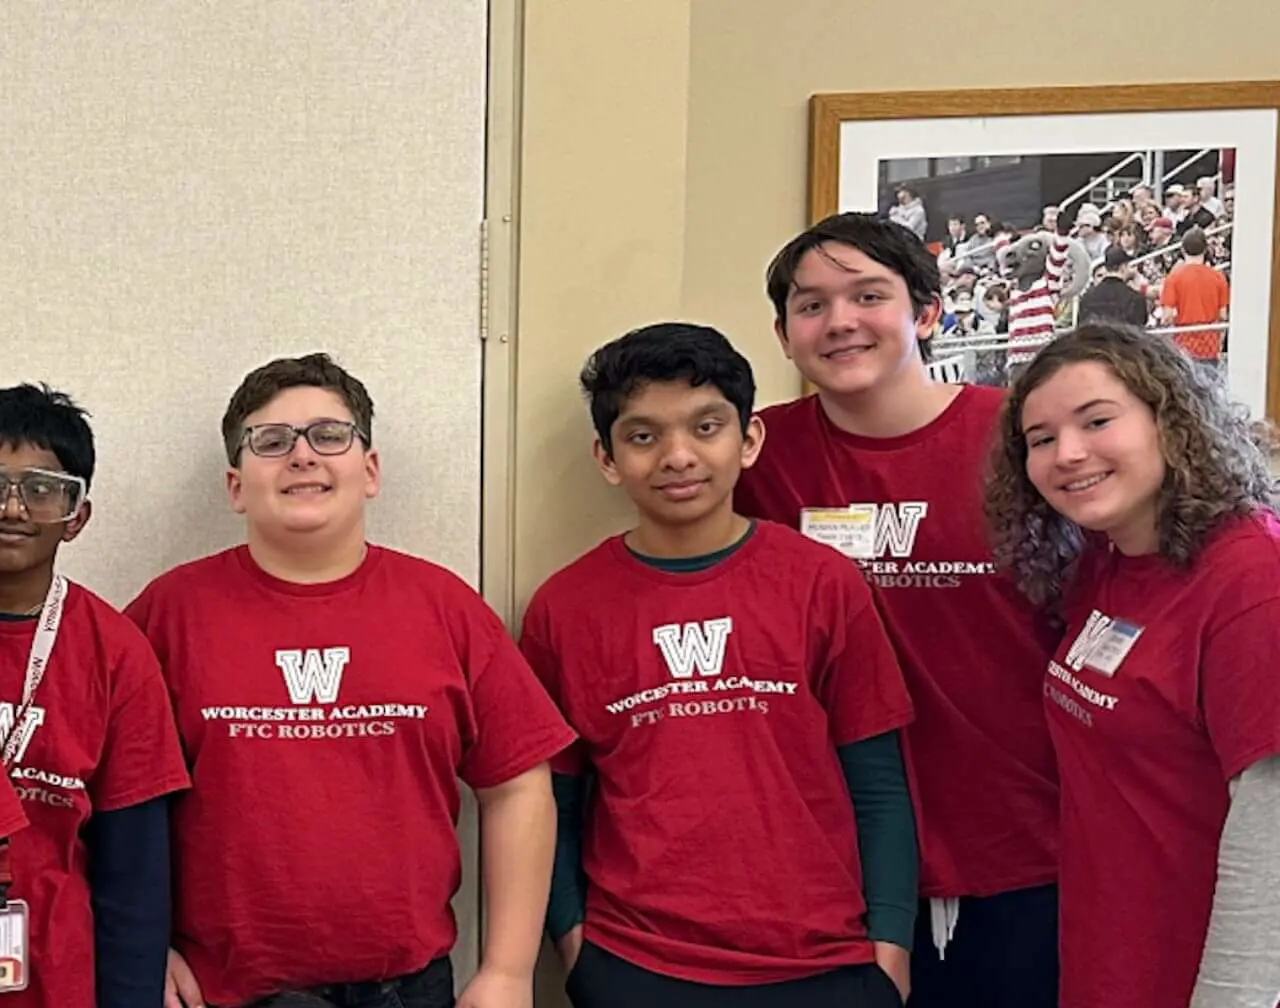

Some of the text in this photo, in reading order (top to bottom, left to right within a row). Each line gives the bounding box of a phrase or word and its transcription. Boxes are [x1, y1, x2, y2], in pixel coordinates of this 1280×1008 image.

[652, 616, 733, 678] W
[275, 646, 350, 705] W
[712, 675, 798, 694] ACAEMY
[201, 703, 428, 721] WORCESTER ACADEMY
[669, 696, 769, 717] ROBOTIS
[228, 720, 396, 739] FTC ROBOTICS
[10, 767, 86, 790] ACADEM
